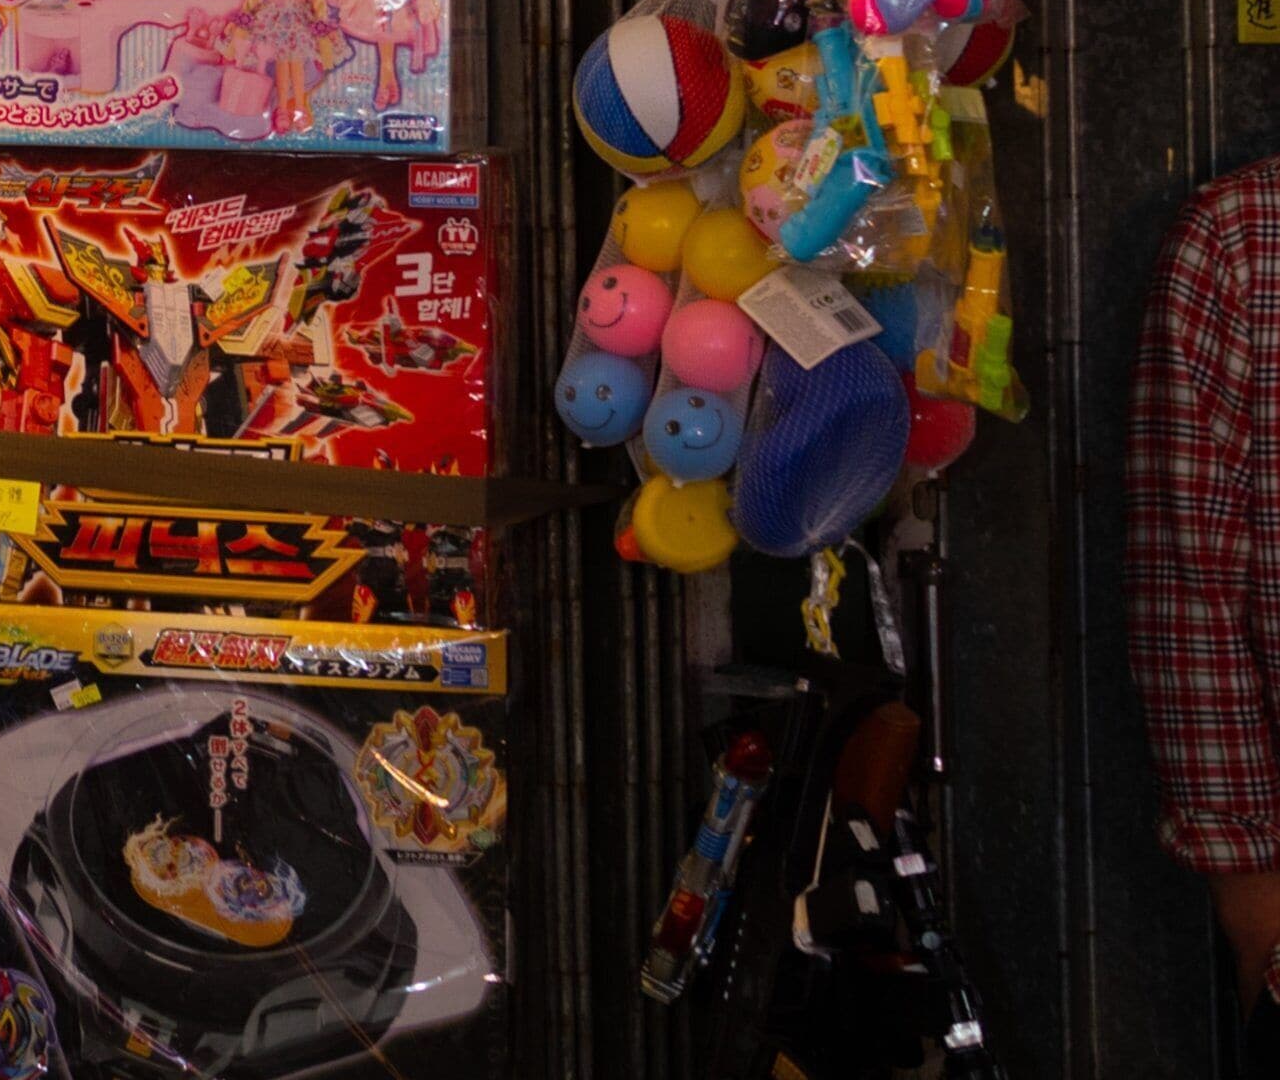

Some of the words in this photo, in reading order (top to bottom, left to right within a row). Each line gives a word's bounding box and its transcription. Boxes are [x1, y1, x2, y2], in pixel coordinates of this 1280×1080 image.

[387, 128, 433, 142] TOMY
[415, 170, 473, 189] ACADEMY
[446, 226, 470, 242] TV
[394, 251, 457, 297] 3단
[417, 297, 473, 322] 합체!
[445, 653, 484, 664] TOMY
